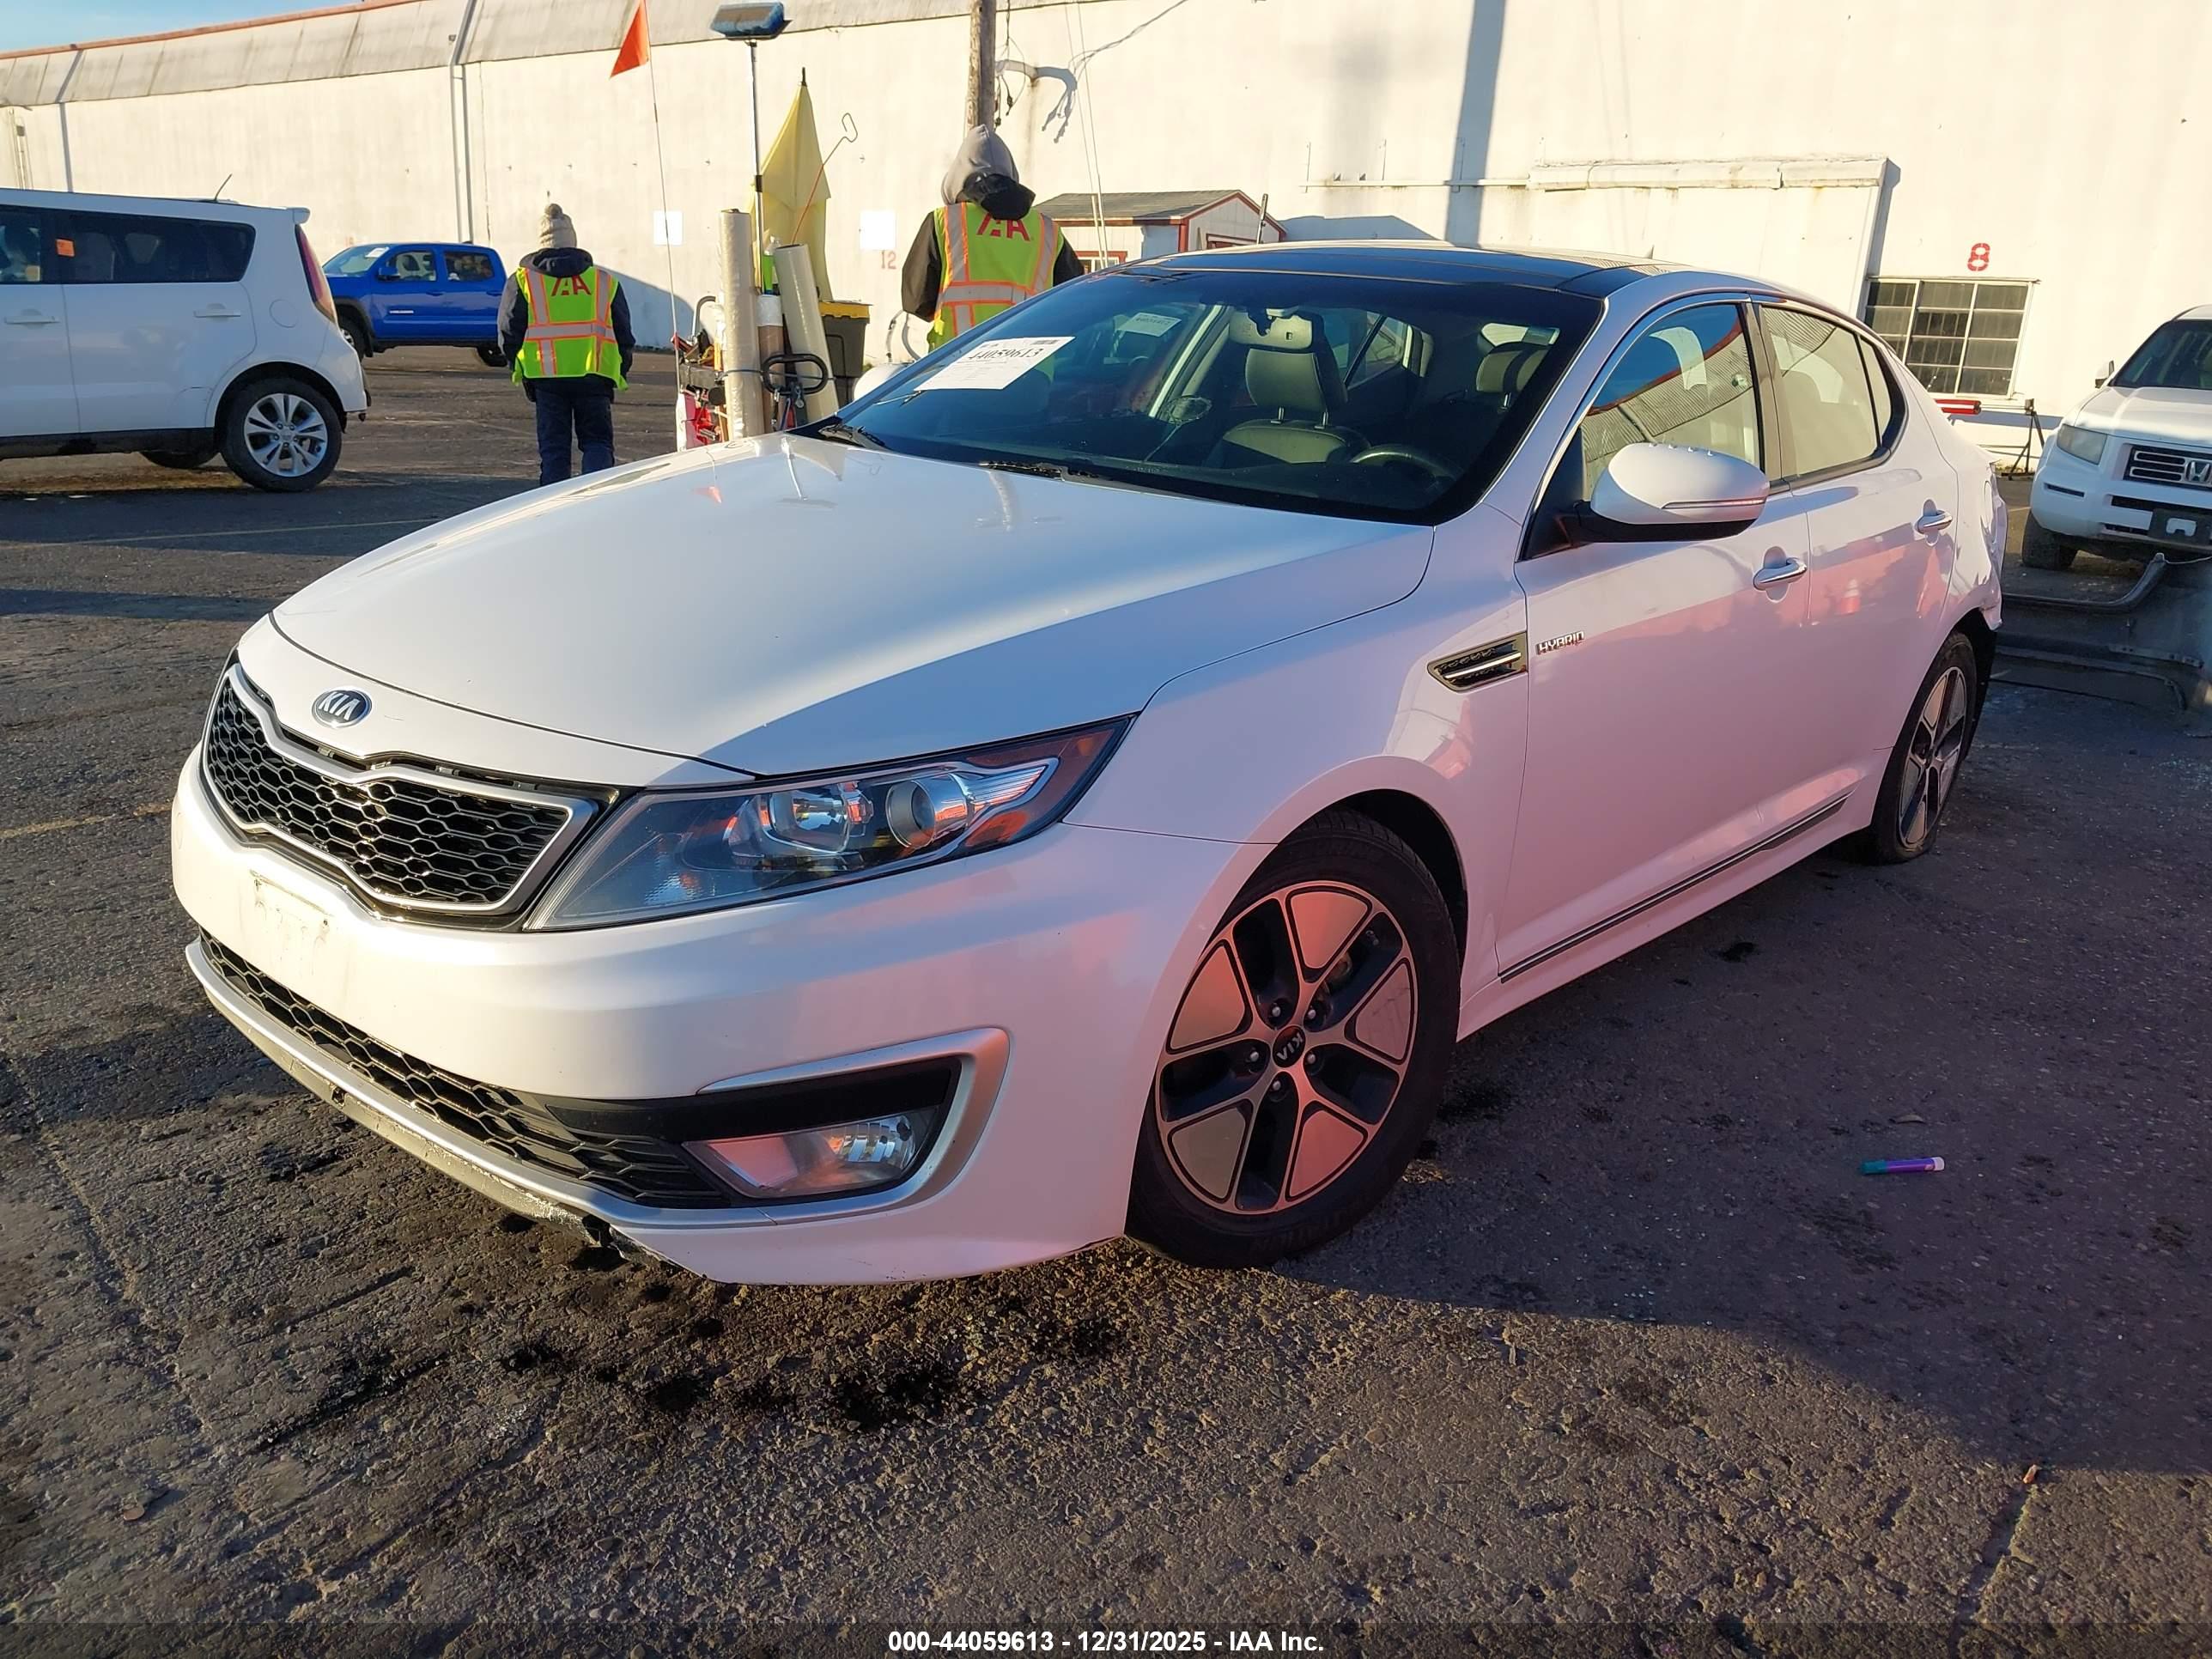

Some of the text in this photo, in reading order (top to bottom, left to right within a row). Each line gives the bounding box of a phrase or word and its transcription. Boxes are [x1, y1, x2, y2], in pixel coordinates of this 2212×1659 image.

[881, 250, 896, 270] 12
[1967, 243, 1990, 271] 8
[318, 691, 361, 721] KIA
